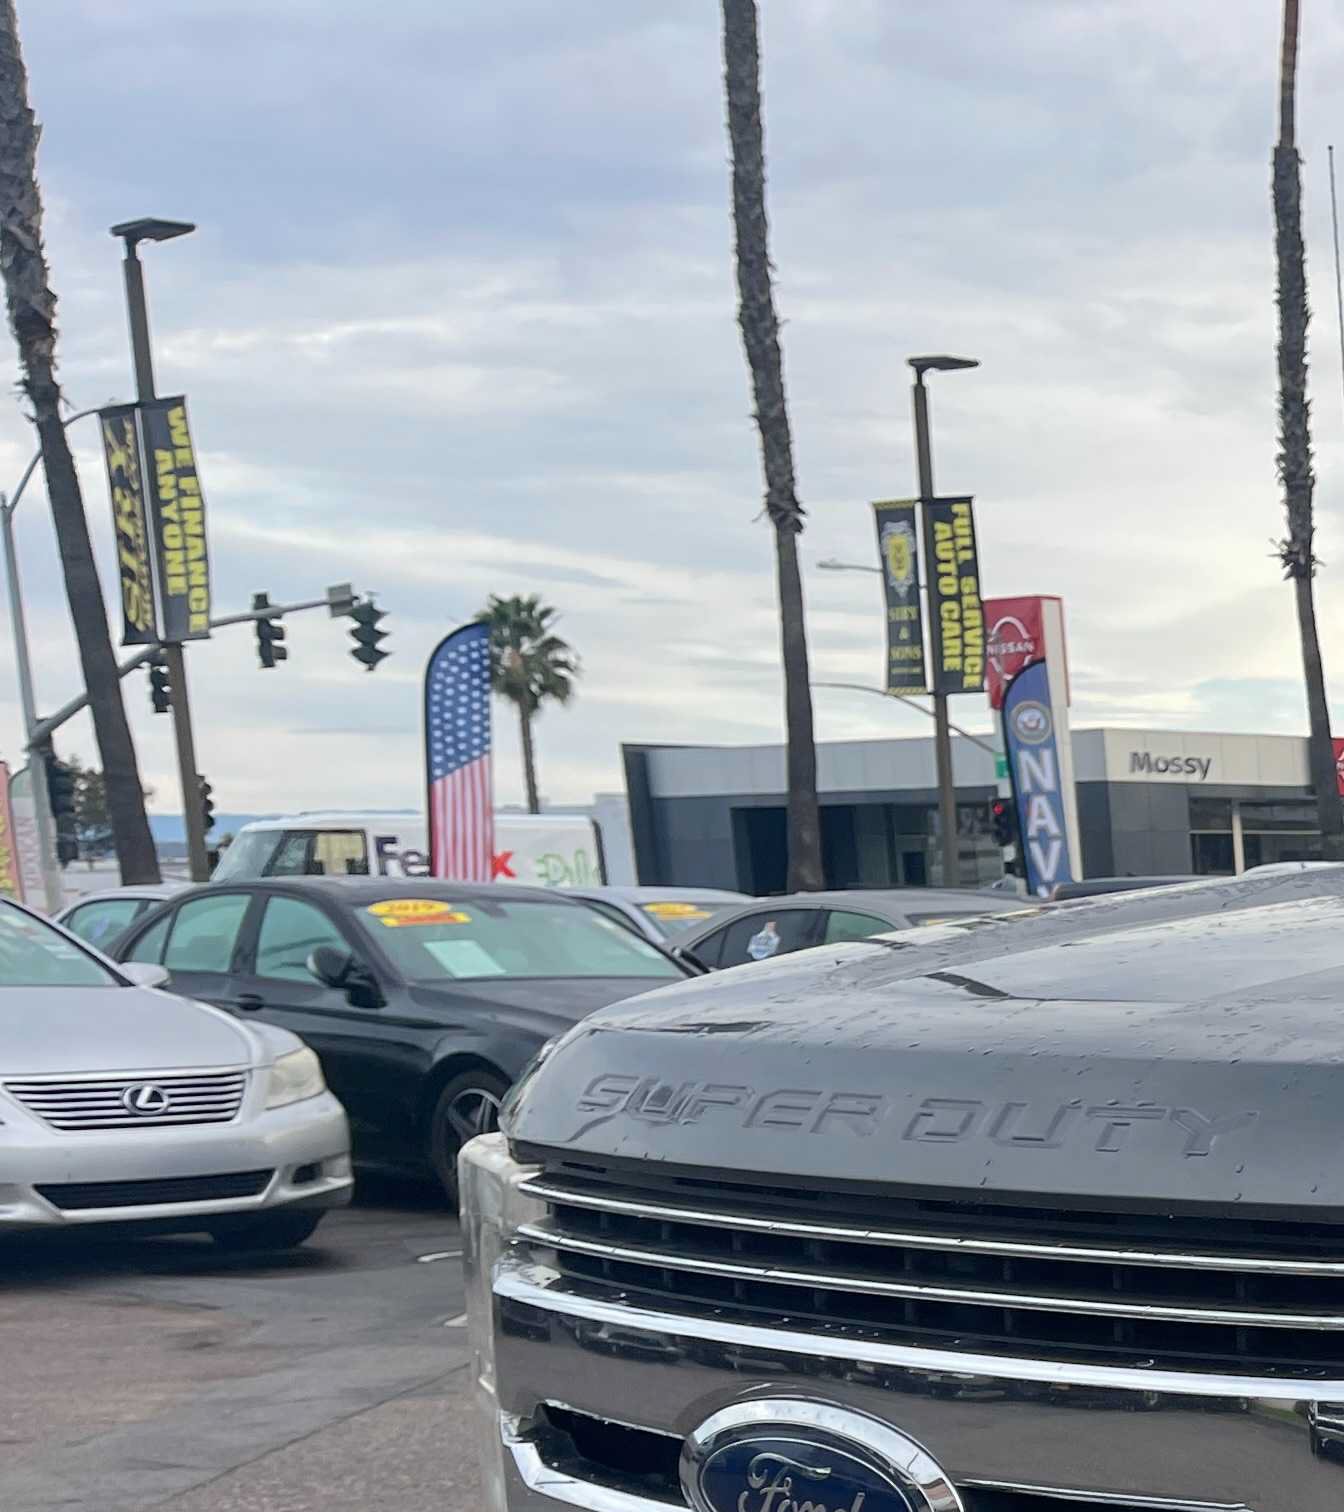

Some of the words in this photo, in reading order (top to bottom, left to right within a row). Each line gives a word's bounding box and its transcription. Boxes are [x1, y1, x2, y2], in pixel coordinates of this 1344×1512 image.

[168, 406, 193, 468] WE
[155, 449, 188, 596] ANYONE
[179, 476, 208, 633] FINANCE
[934, 521, 959, 596] AUTO
[952, 503, 974, 565] FULL
[940, 601, 962, 672] CARE
[960, 576, 983, 688] SERVICE
[986, 641, 1034, 656] NISSAN
[1129, 751, 1212, 780] Mossy
[375, 836, 517, 878] Fex
[1017, 749, 1061, 898] NAV
[567, 1073, 890, 1143] SUPER
[901, 1098, 1261, 1159] DUTY
